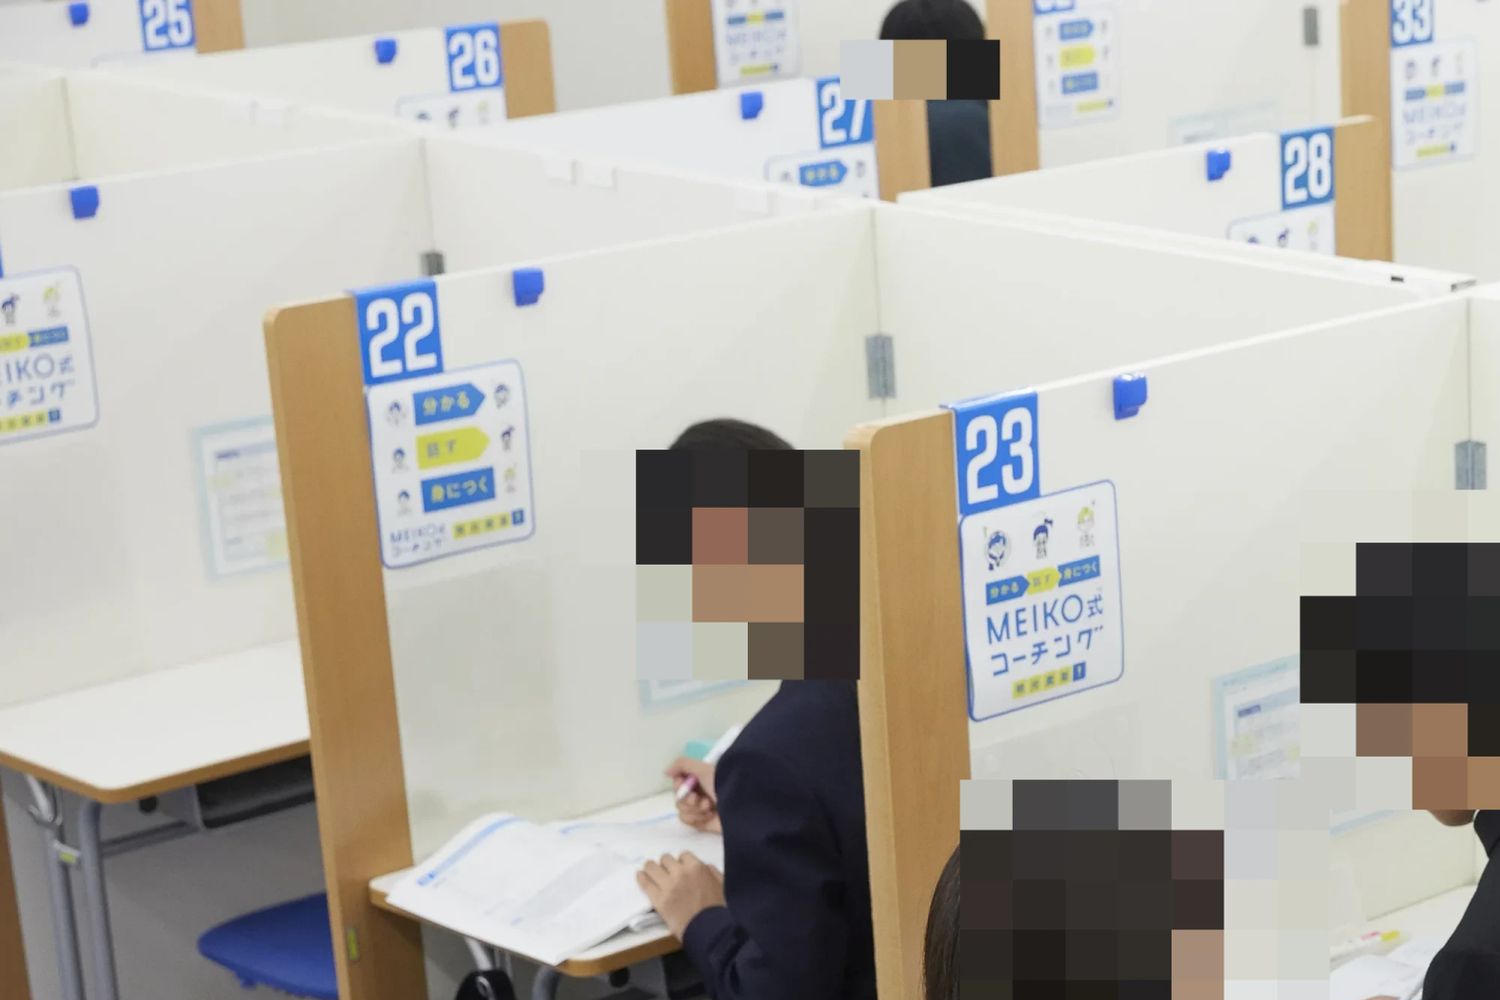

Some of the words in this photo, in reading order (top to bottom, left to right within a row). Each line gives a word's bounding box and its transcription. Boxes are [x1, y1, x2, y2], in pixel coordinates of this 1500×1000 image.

[144, 0, 191, 48] 25
[1392, 0, 1431, 43] 33
[449, 29, 500, 88] 26
[1285, 132, 1331, 204] 28
[366, 292, 437, 378] 22
[965, 407, 1034, 504] 23
[987, 592, 1103, 645] MEIKO式
[990, 625, 1103, 676] コーチング
